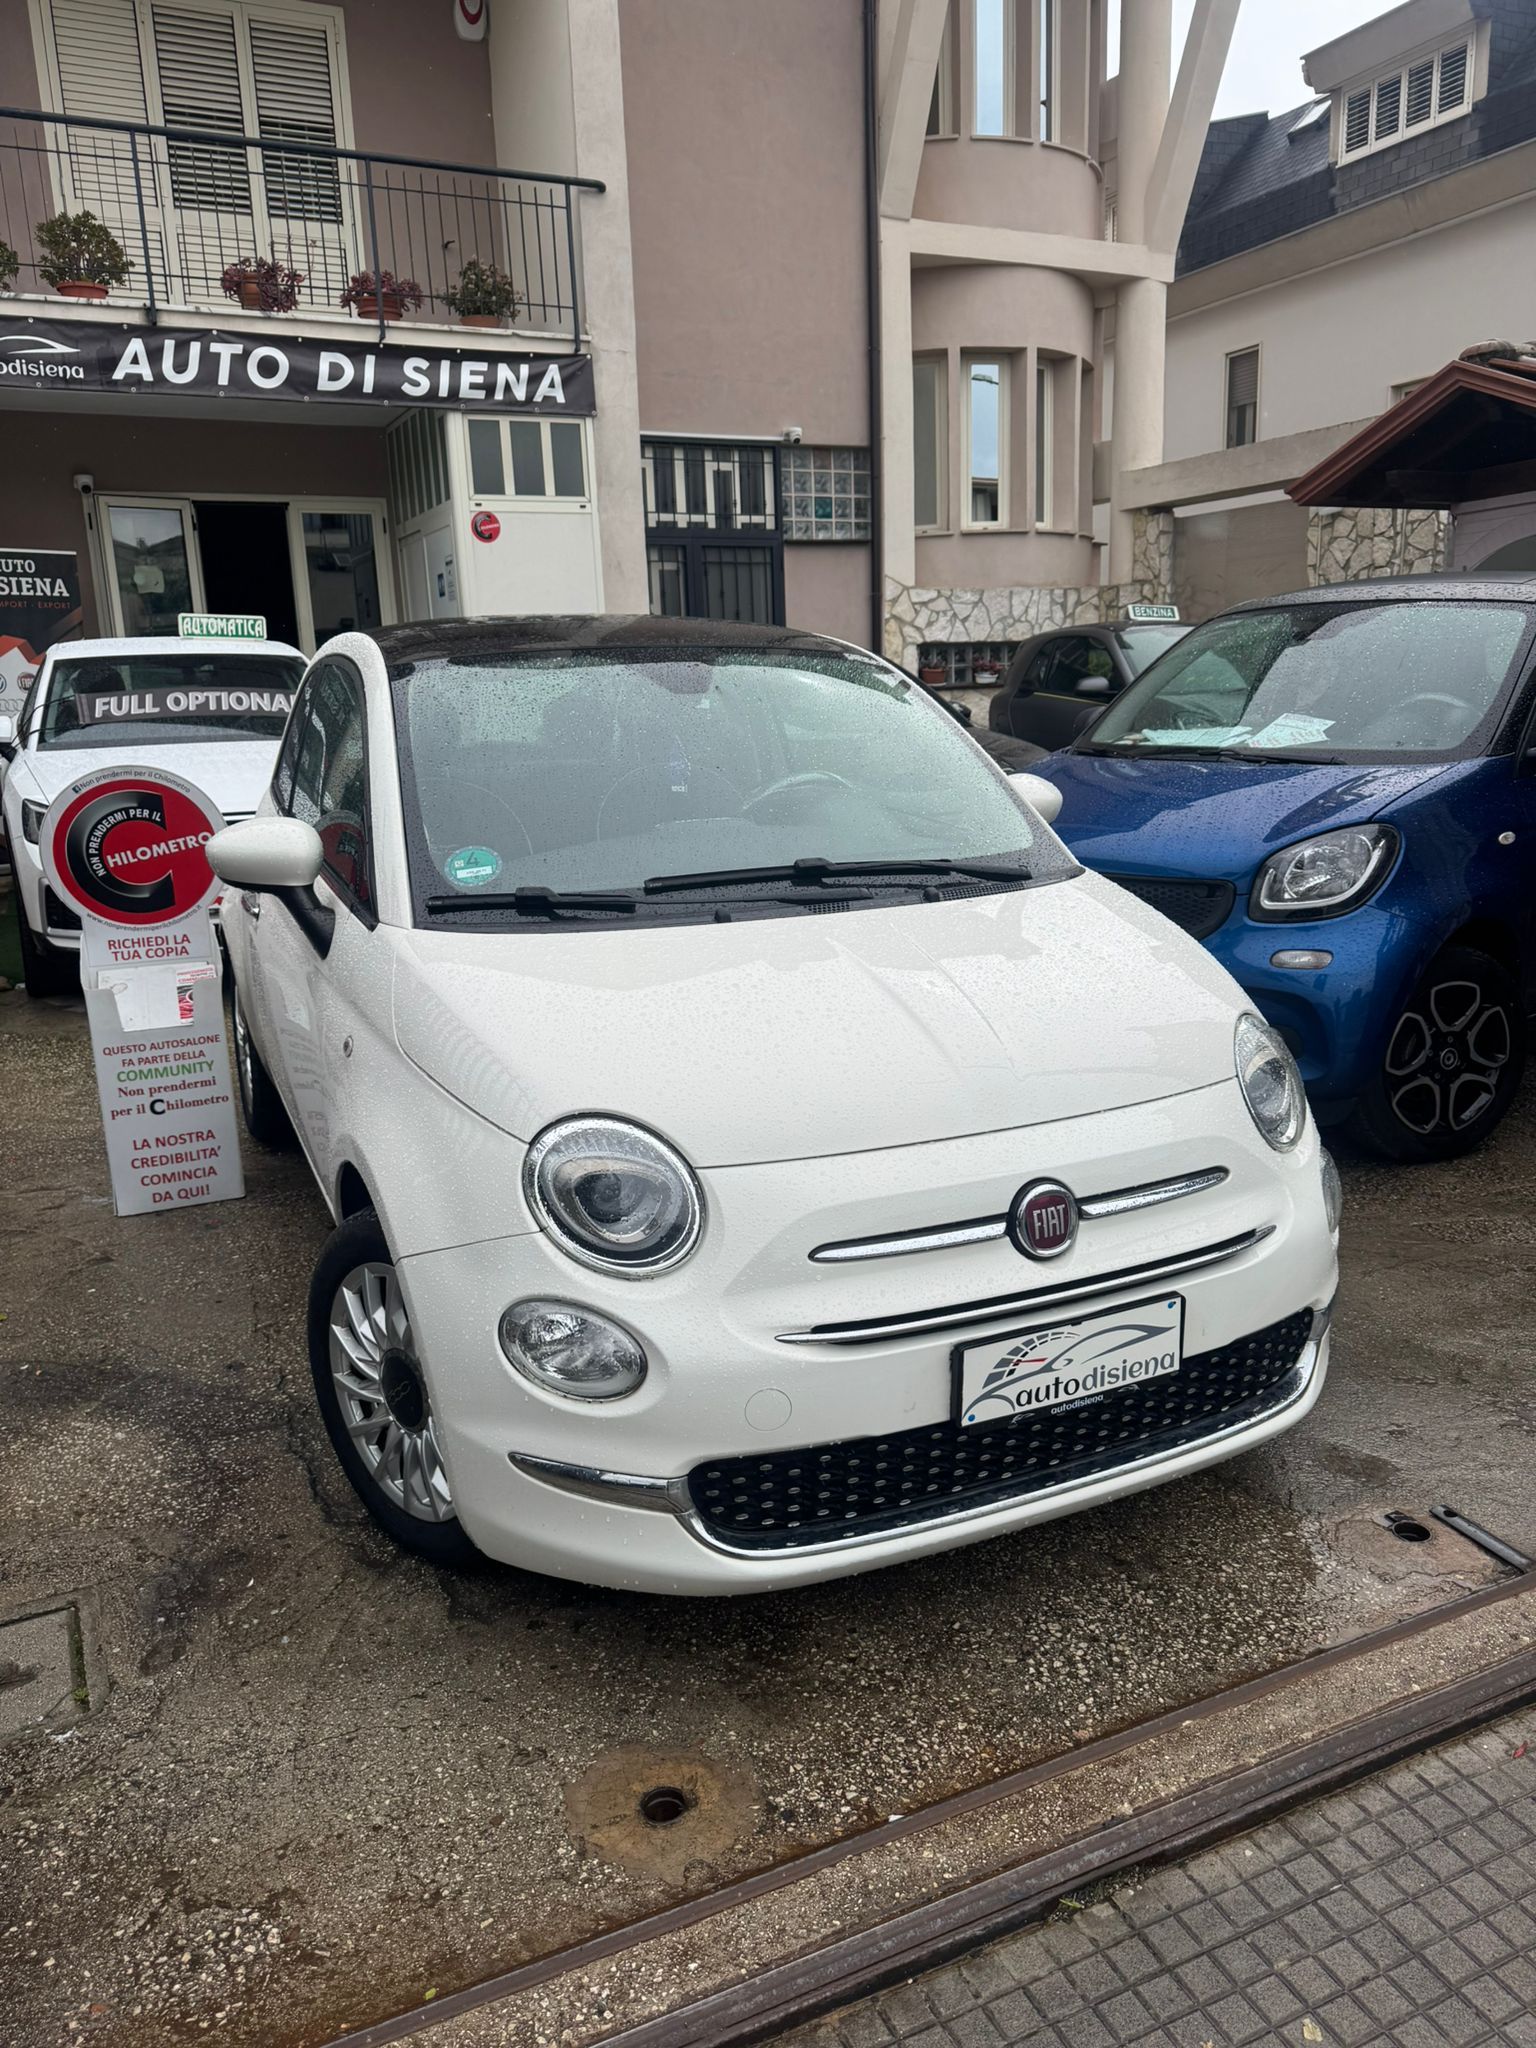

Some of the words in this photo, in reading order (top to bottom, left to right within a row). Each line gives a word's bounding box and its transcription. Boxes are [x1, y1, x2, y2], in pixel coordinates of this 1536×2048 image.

[112, 338, 289, 389] AUTO
[317, 352, 375, 393] DI
[401, 357, 566, 403] SIENA
[0, 577, 70, 597] SIENA
[38, 601, 71, 609] EXPORT
[1134, 606, 1174, 617] BENZINA
[182, 617, 264, 637] AUTOMATICA
[95, 693, 160, 718] FULL
[166, 691, 297, 714] OPTIONA
[80, 779, 95, 790] Non
[95, 769, 133, 783] prendermi
[154, 771, 191, 793] Chilometro
[129, 808, 150, 819] PER
[151, 811, 162, 821] IL
[89, 810, 127, 854] PRENDERMI
[90, 856, 106, 877] NON
[108, 935, 169, 950] RICHIEDI
[173, 934, 191, 945] LA
[112, 949, 142, 961] TUA
[145, 946, 190, 958] COPIA
[103, 1043, 146, 1056] QUESTO
[149, 1034, 221, 1051] AUTOSALONE
[121, 1058, 135, 1067] FA
[138, 1054, 171, 1065] PARTE
[173, 1050, 206, 1061] DELLA
[117, 1060, 215, 1082] COMMUNITY
[117, 1086, 144, 1098] Non
[148, 1076, 217, 1097] prendermi
[110, 1107, 133, 1120] per
[137, 1103, 146, 1114] il
[149, 1095, 229, 1115] Chilometro
[133, 1139, 151, 1151] LA
[155, 1129, 216, 1148] NOSTRA
[131, 1145, 221, 1169] CREDIBILITA'
[140, 1166, 217, 1186] COMINCIA
[152, 1191, 174, 1203] DA
[177, 1184, 210, 1200] QUI!
[1032, 1204, 1066, 1240] FIAT
[1016, 1352, 1175, 1407] autodisiena
[1051, 1394, 1104, 1415] autodisiena
